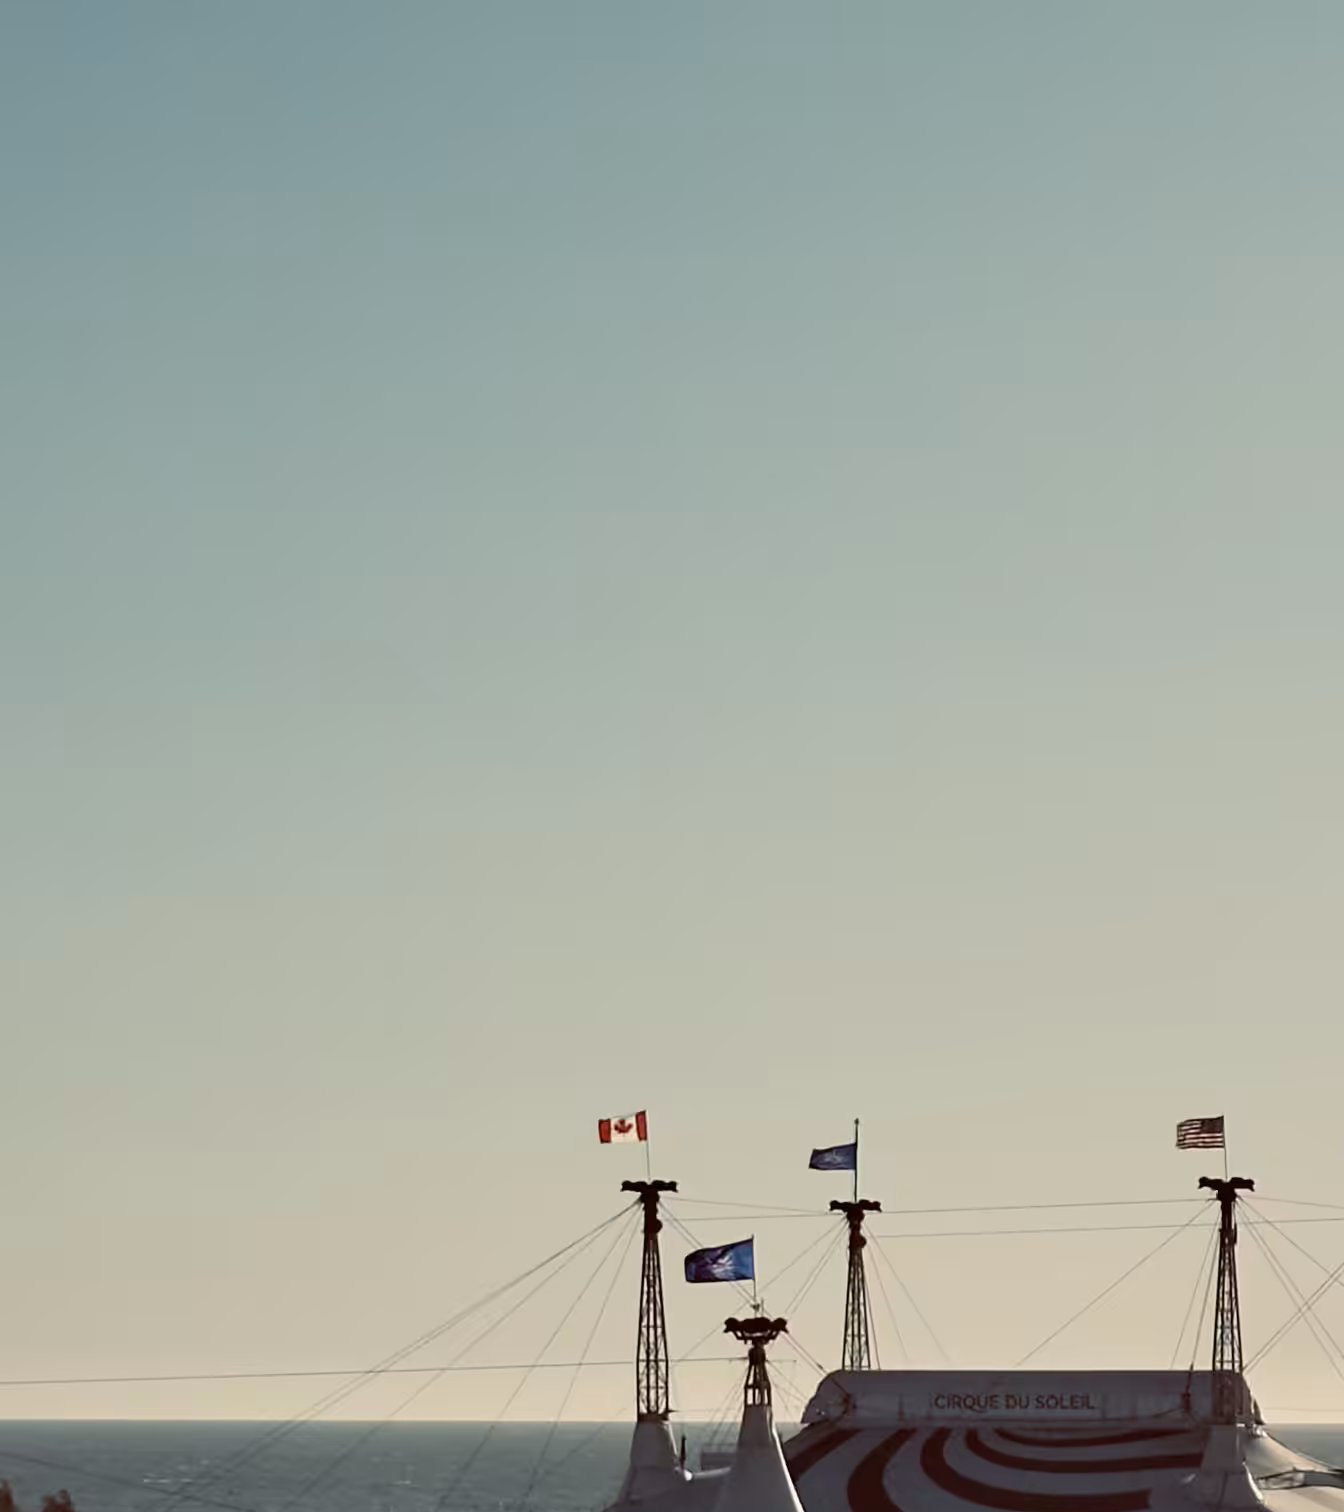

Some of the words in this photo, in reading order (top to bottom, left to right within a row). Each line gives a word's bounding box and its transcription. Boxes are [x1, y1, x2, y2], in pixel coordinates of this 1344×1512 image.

[934, 1393, 999, 1413] CIRQUE
[1005, 1393, 1030, 1410] DU
[1035, 1393, 1096, 1410] SOLEIL
